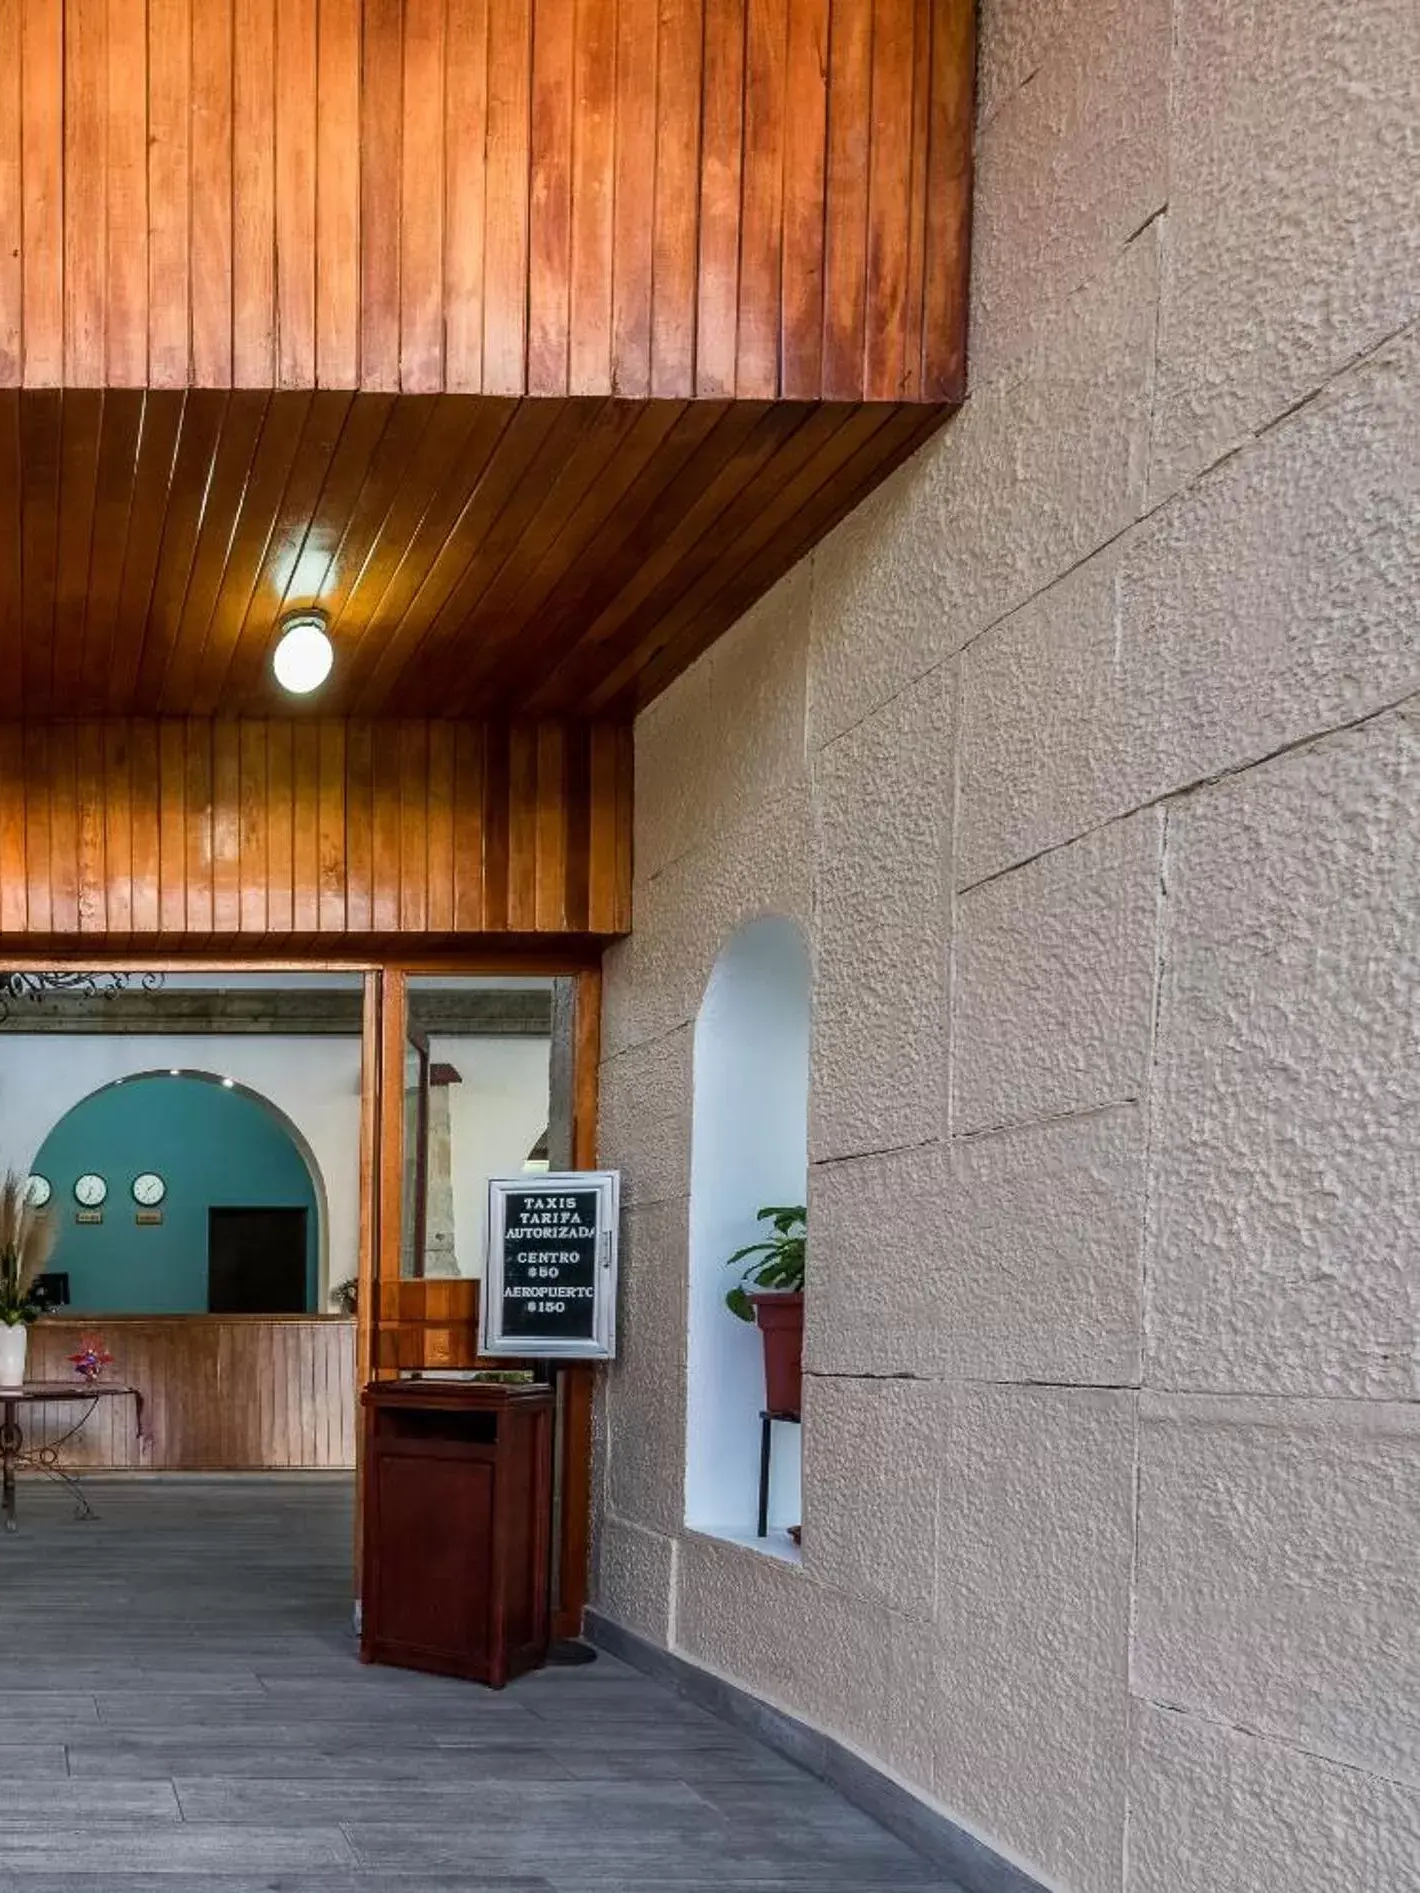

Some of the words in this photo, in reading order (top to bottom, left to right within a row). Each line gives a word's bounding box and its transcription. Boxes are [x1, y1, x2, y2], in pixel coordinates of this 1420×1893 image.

[524, 1198, 576, 1209] TAXIS
[520, 1212, 581, 1223] TARIFA
[518, 1252, 580, 1263] CENTRO
